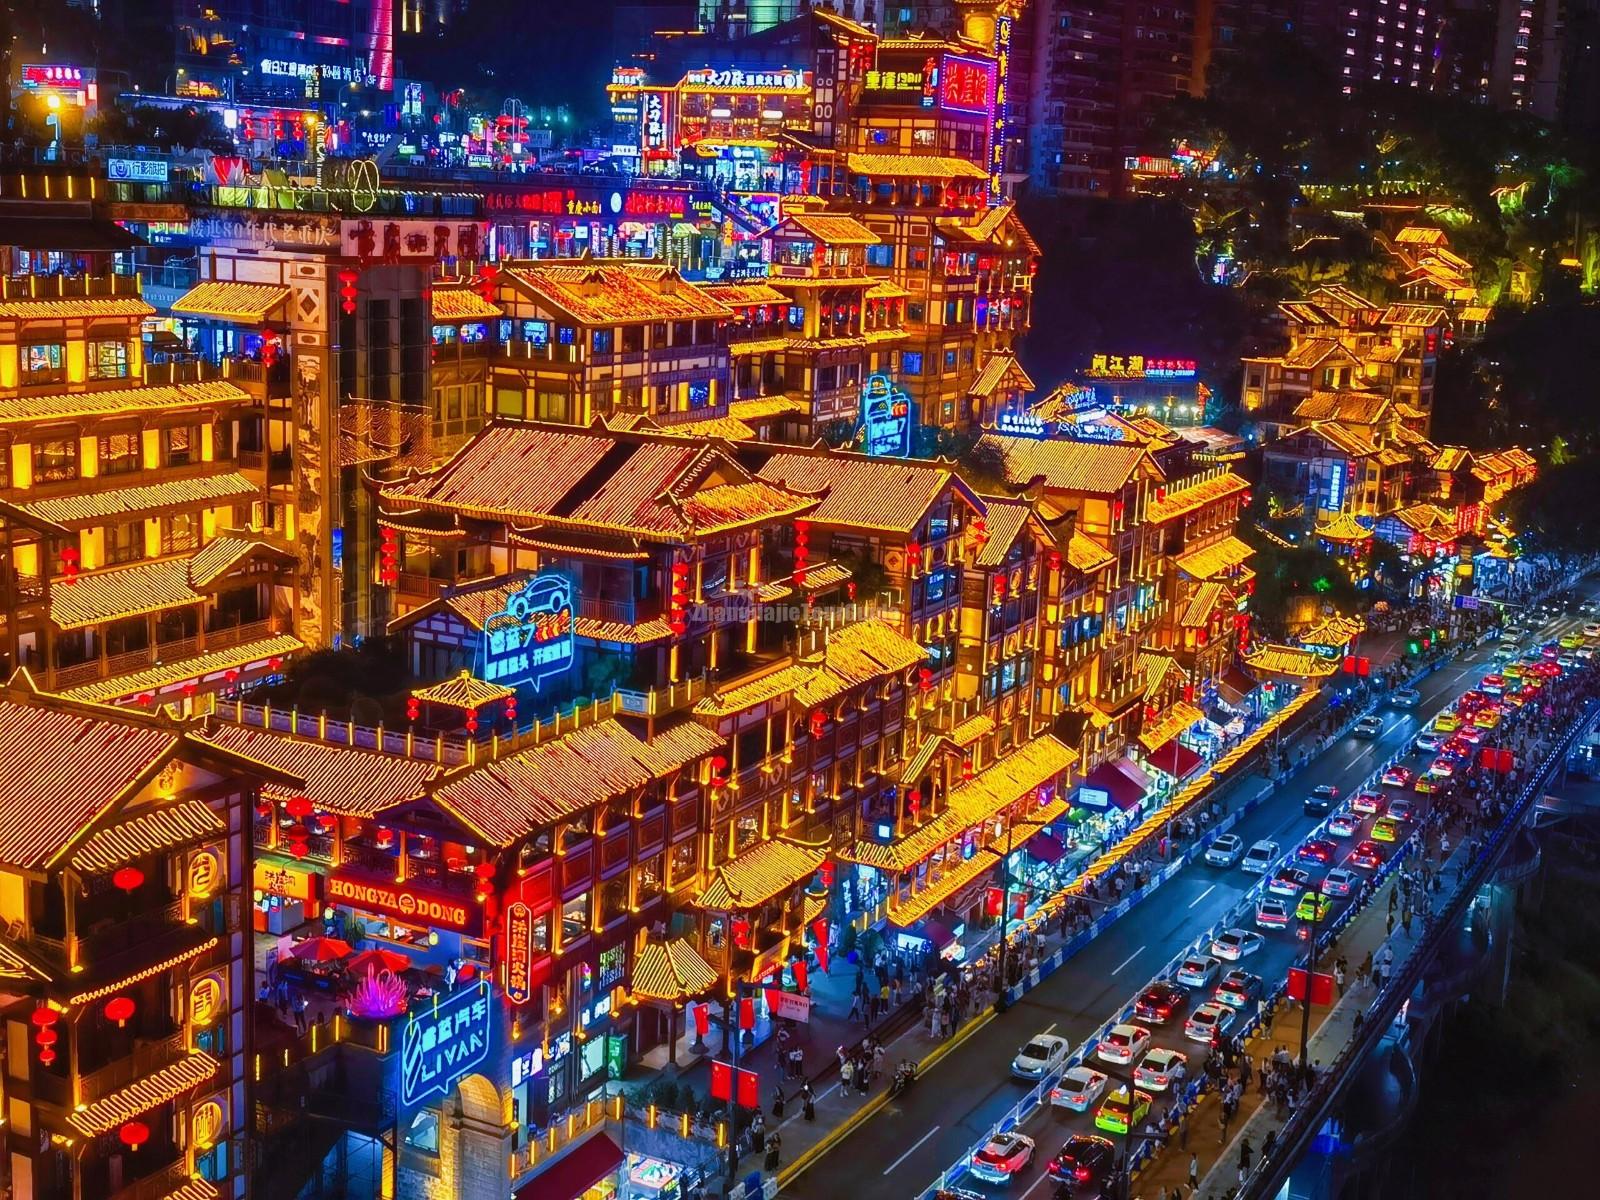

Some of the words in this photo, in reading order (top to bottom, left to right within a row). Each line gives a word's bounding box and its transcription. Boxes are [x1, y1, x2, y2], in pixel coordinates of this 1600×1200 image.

[330, 879, 398, 909] HONGYA
[417, 899, 465, 925] DONG
[421, 1033, 484, 1083] LIVAN
